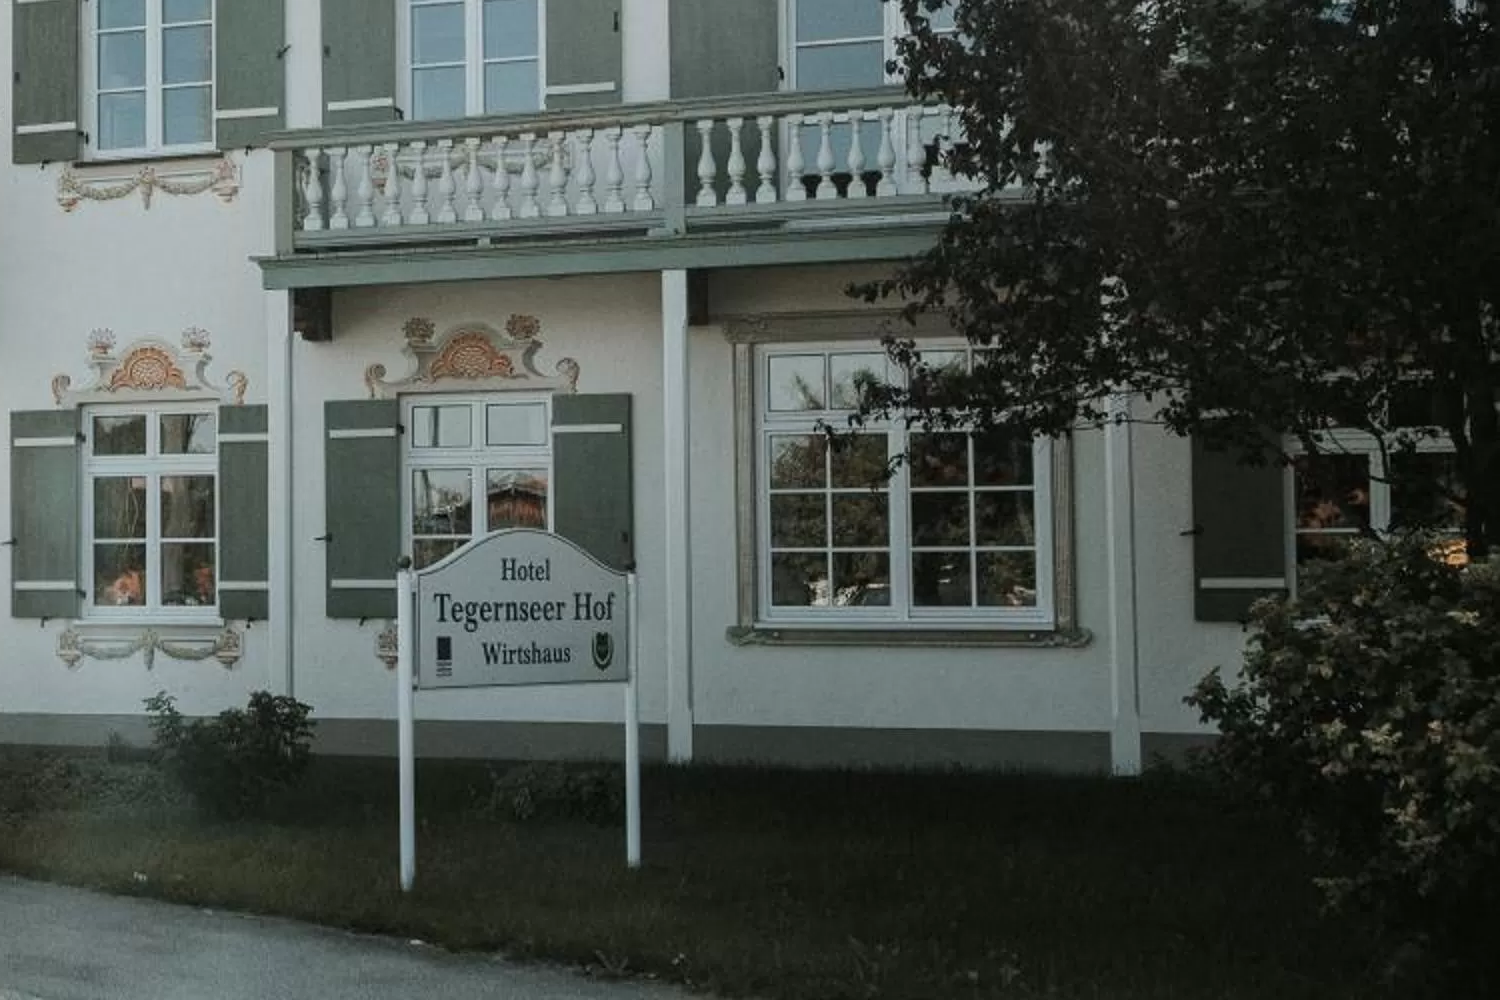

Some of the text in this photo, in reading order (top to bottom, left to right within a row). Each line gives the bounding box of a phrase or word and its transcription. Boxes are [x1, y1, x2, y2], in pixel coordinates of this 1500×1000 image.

[501, 558, 550, 581] Hotel
[433, 591, 616, 632] Tegernseer Hof
[482, 641, 571, 665] Wirtshaus
